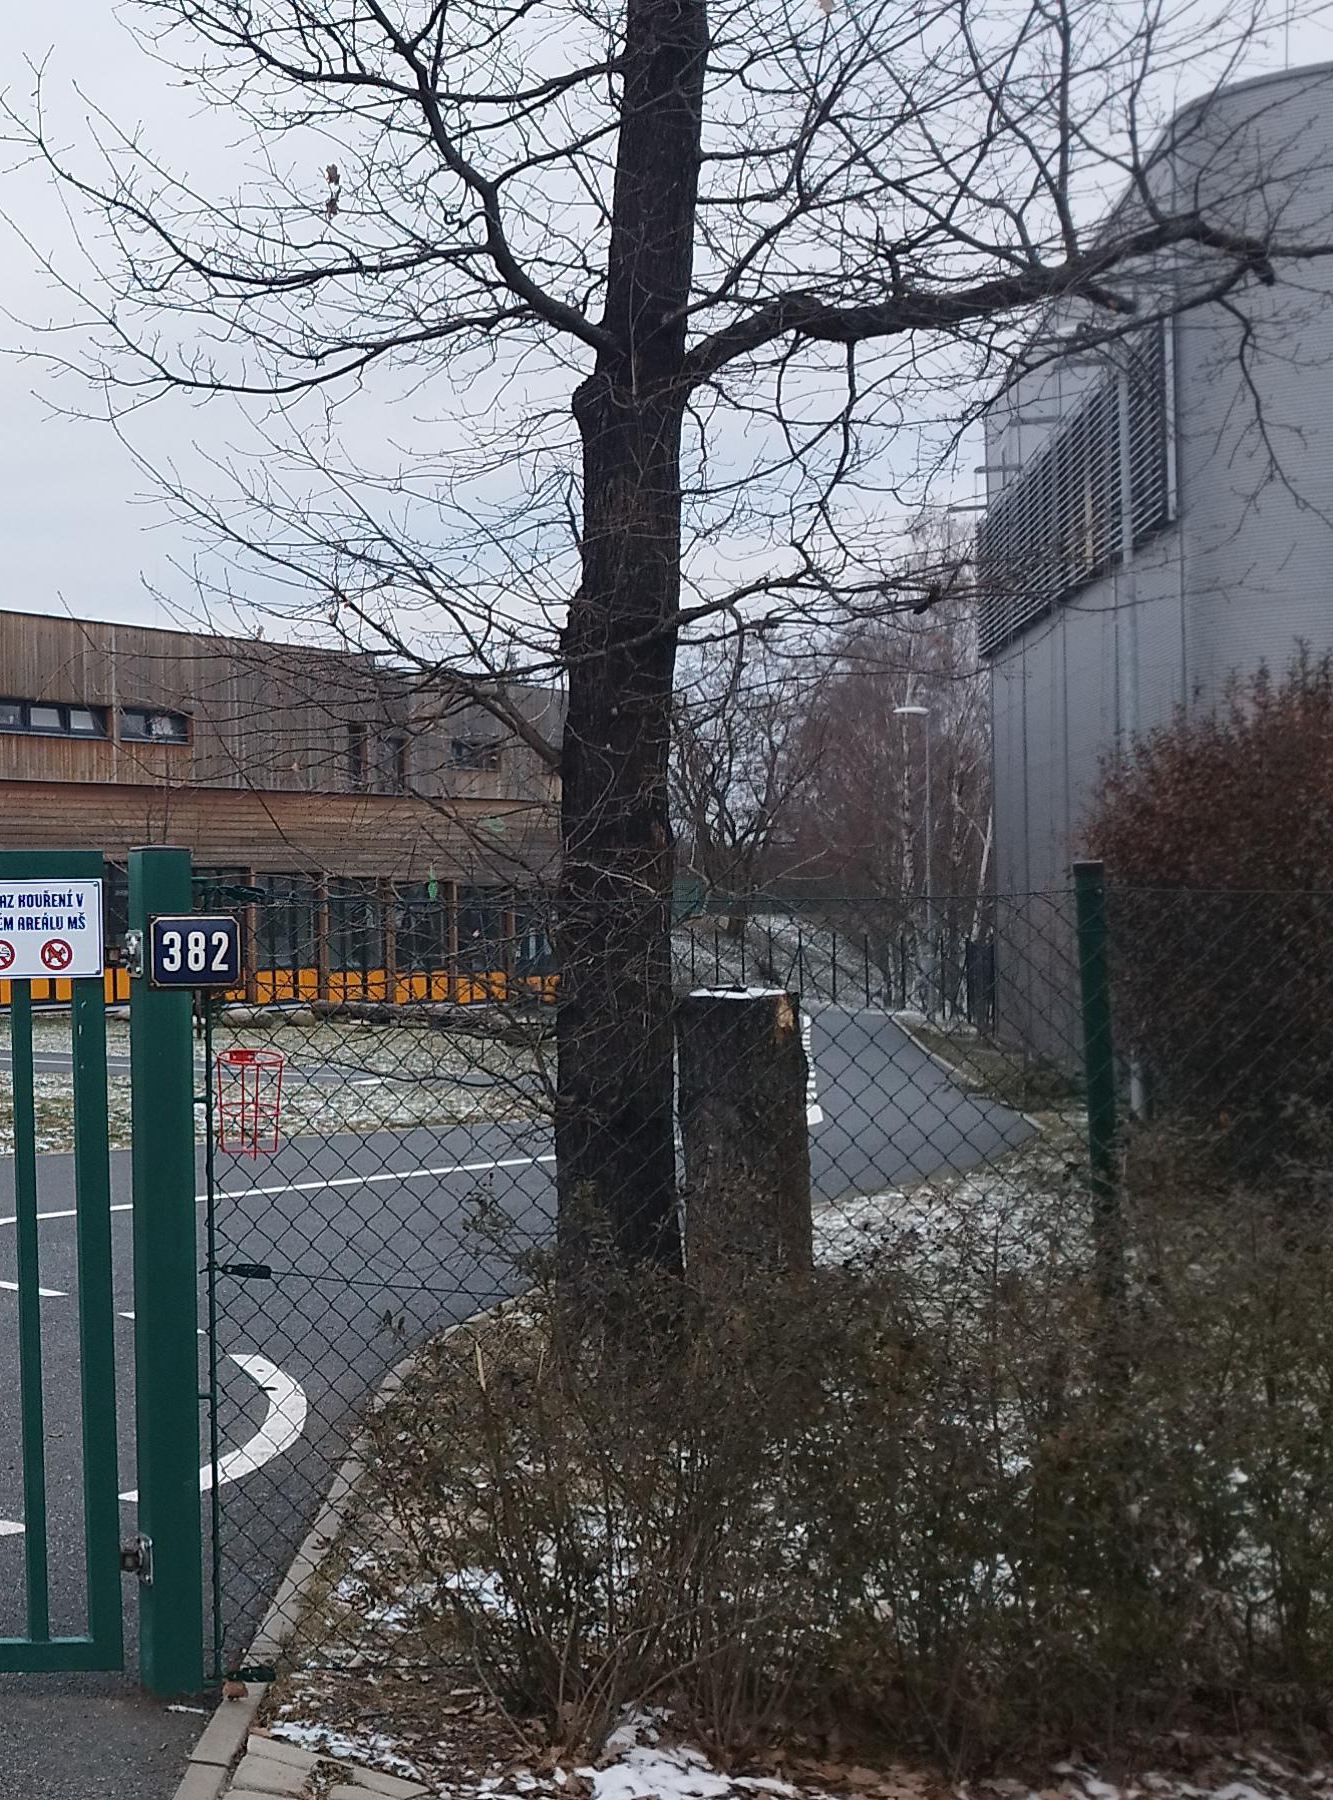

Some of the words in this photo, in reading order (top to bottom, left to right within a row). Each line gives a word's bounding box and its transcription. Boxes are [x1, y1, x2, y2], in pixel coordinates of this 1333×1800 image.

[17, 888, 74, 908] KOUŘENÍ
[76, 893, 84, 908] V
[17, 912, 64, 931] AREÁLU
[67, 911, 86, 930] MŠ
[161, 930, 230, 972] 382
